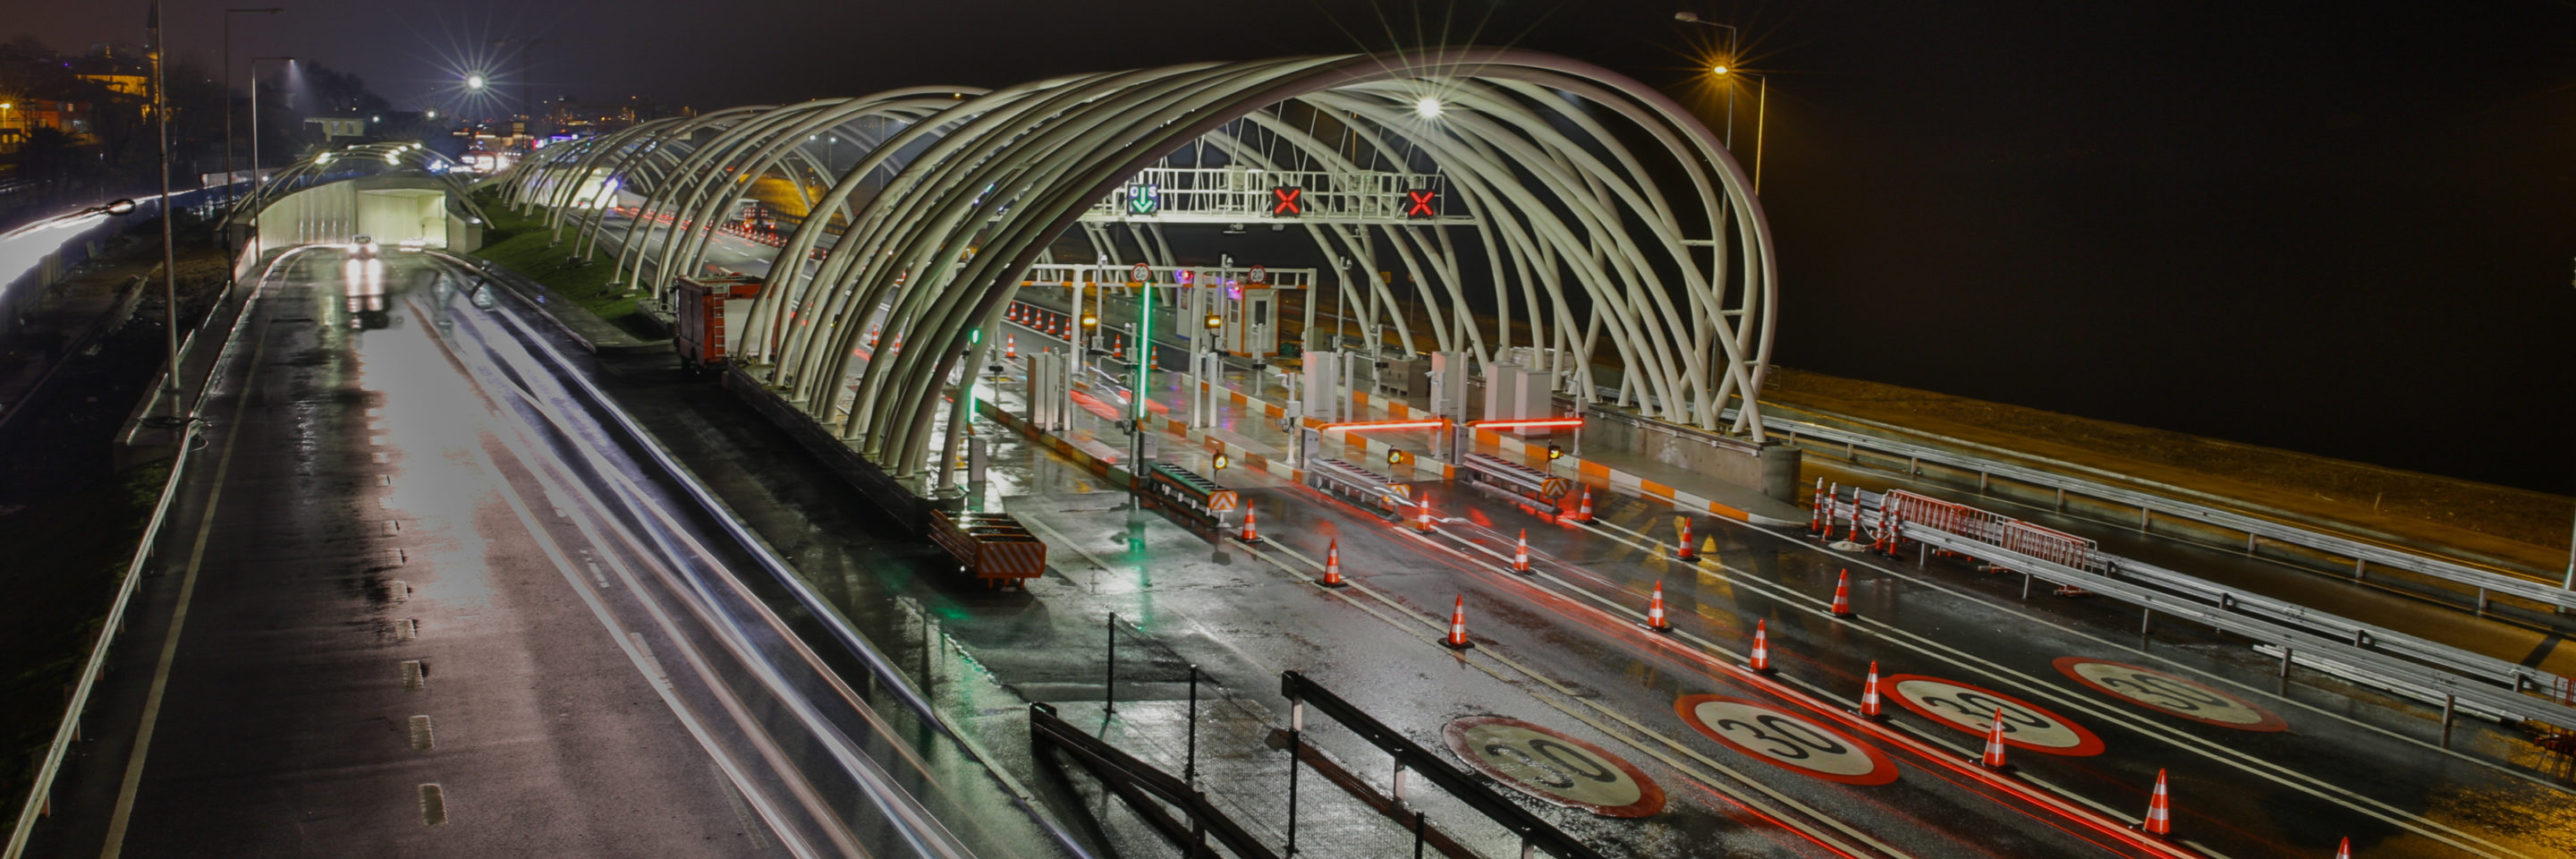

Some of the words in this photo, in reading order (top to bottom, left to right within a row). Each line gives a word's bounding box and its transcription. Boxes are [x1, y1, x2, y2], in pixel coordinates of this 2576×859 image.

[1921, 693, 2051, 733] 30
[2100, 674, 2231, 711] 30
[1717, 714, 1848, 760] 30
[1485, 739, 1617, 789] 30
